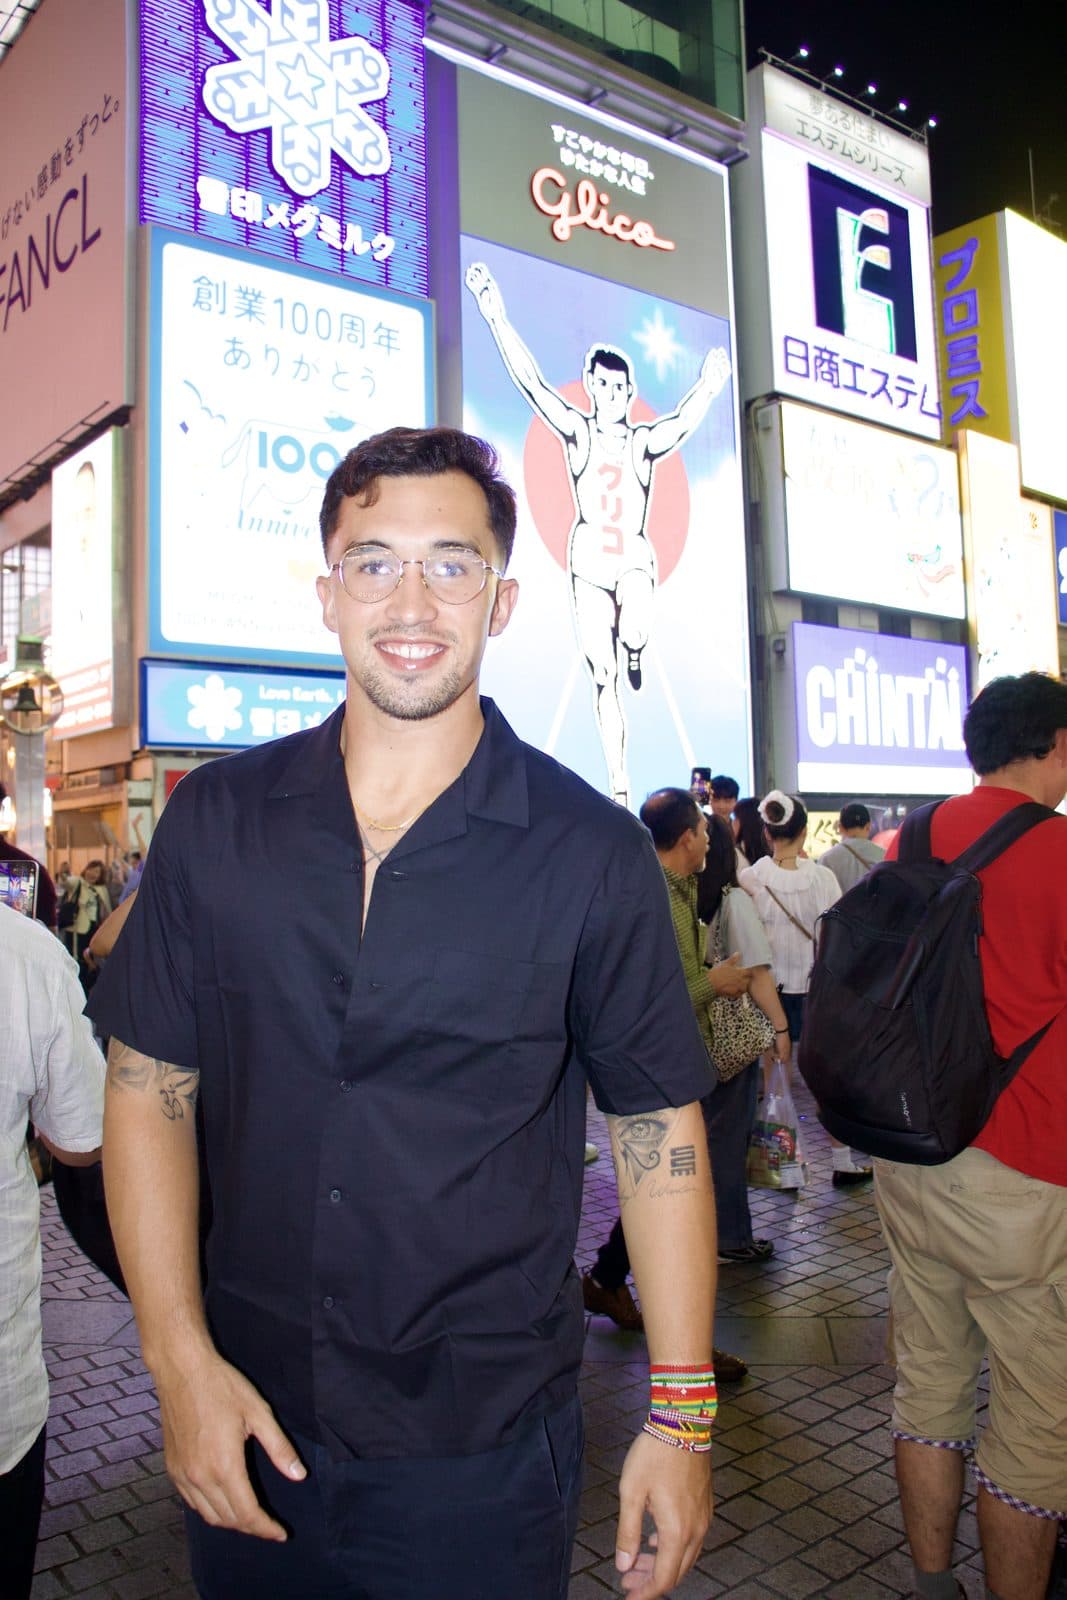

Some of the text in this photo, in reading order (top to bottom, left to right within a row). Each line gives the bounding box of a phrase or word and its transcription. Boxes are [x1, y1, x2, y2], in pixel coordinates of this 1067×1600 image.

[196, 175, 396, 261] 印メグミルク
[531, 168, 676, 251] Glico
[192, 275, 401, 356] 創業100周年
[223, 337, 376, 398] ありがとう
[784, 335, 941, 419] 日商エステム
[598, 460, 624, 556] グリコ
[249, 707, 322, 736] 印メ
